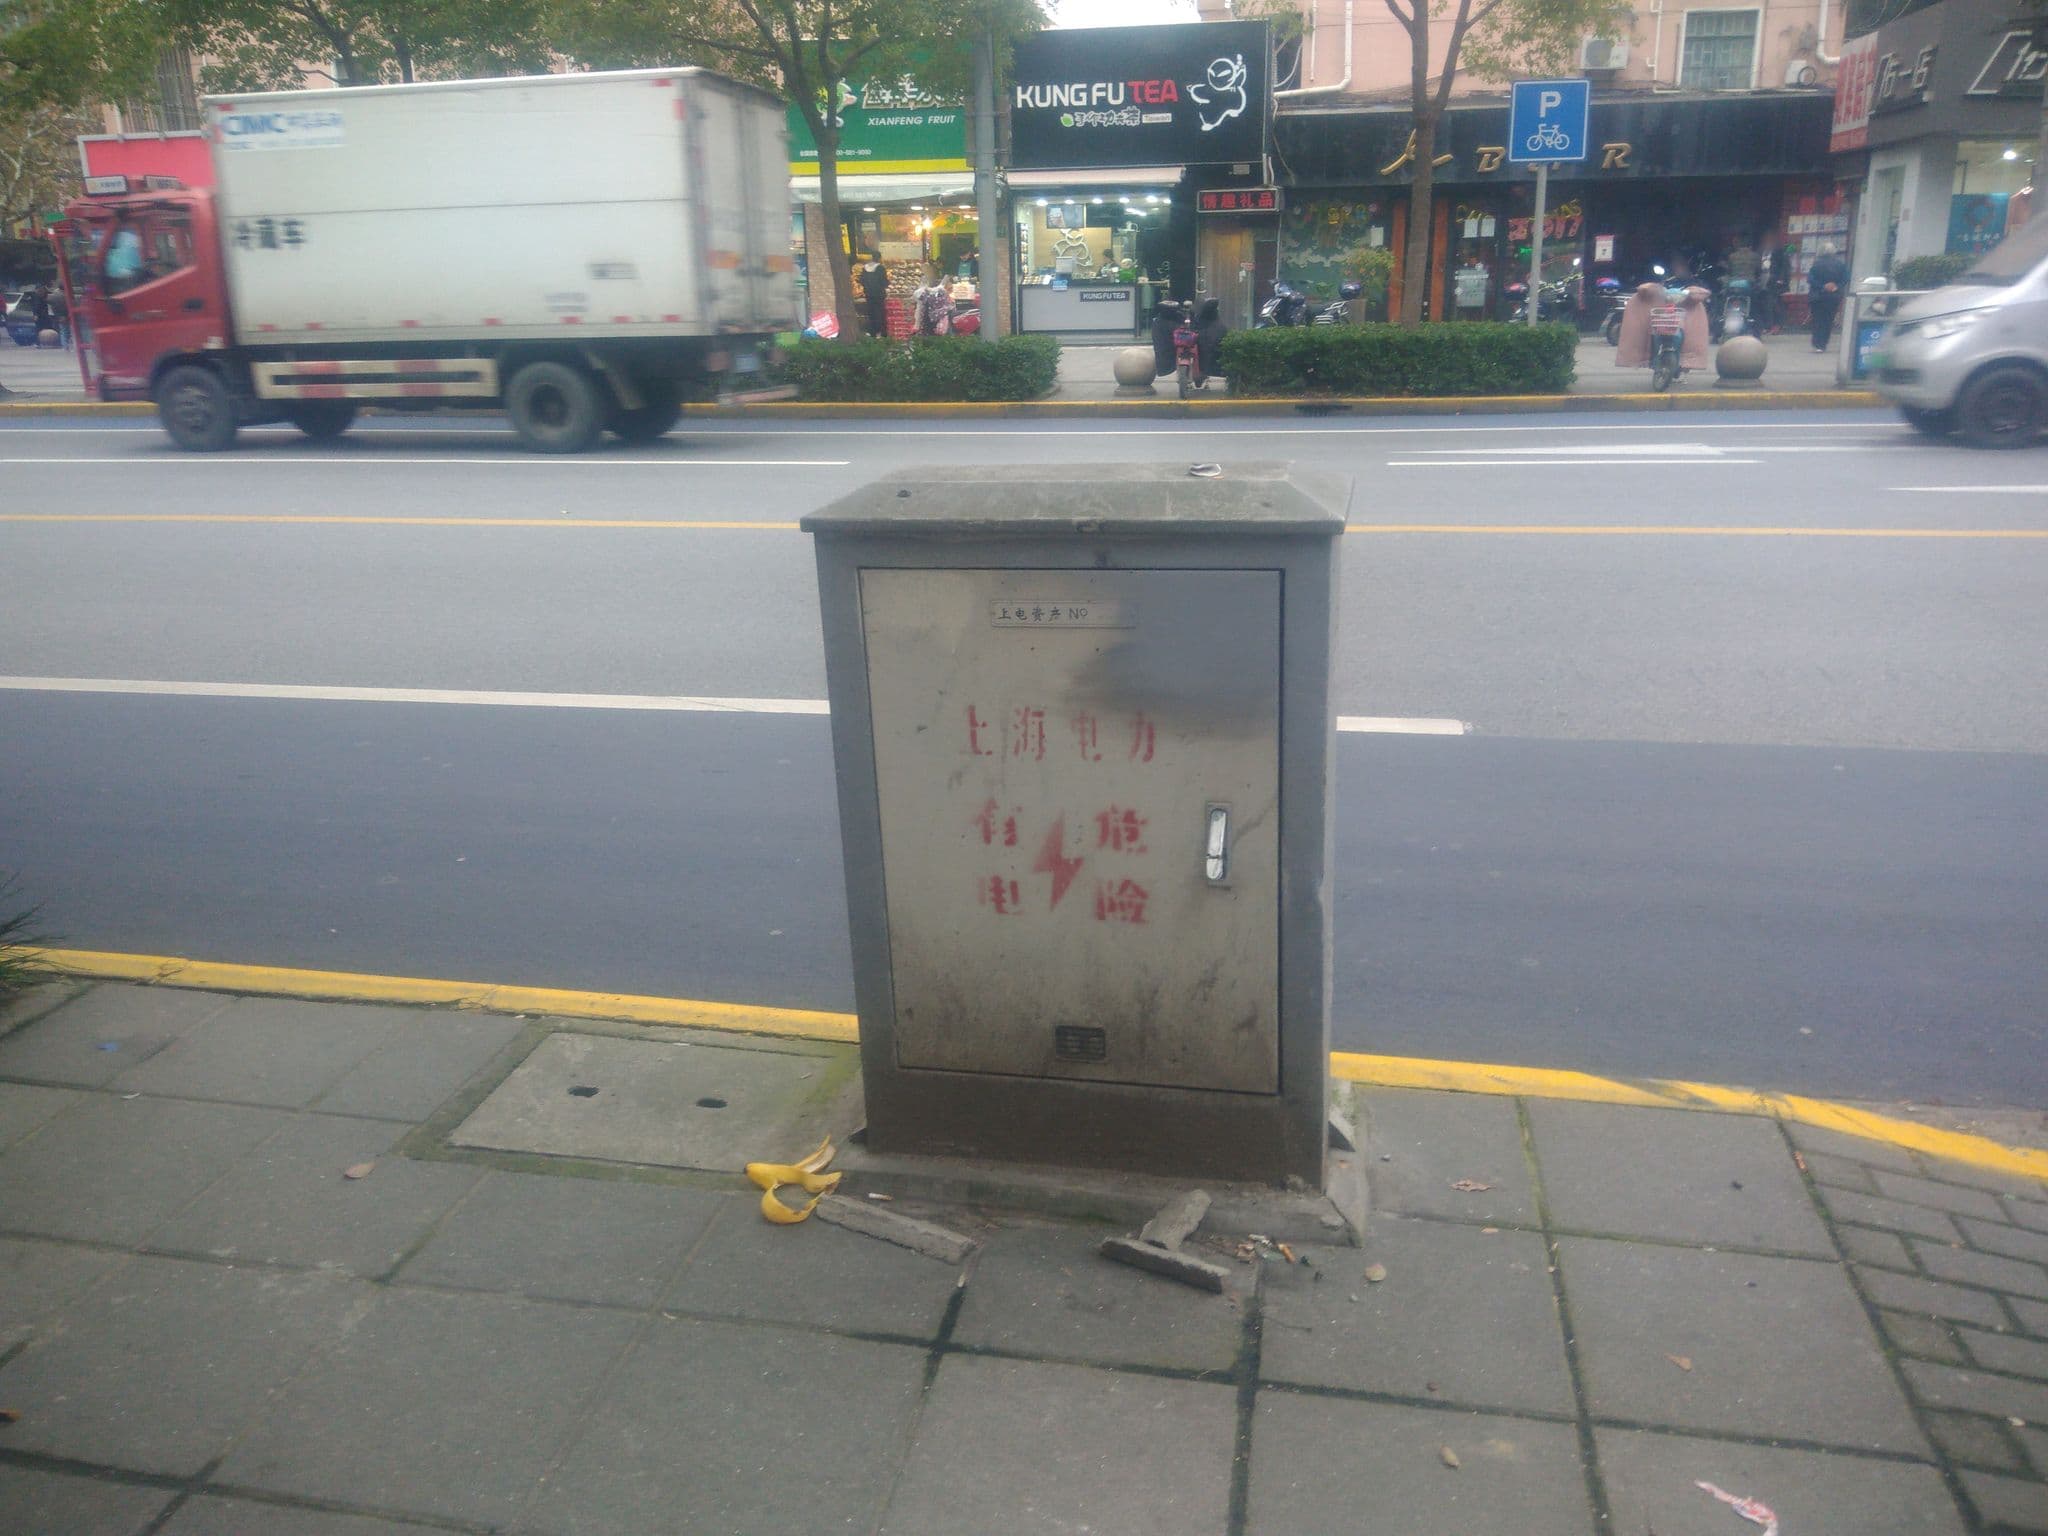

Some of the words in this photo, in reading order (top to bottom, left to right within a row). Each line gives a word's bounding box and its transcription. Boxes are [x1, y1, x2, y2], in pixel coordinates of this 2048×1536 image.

[1016, 83, 1087, 108] KUNG
[1092, 82, 1125, 105] FU
[1127, 79, 1179, 104] TEA
[1540, 91, 1562, 118] P
[867, 116, 923, 126] XIANFENG
[928, 115, 956, 124] FRUIT
[998, 606, 1061, 622] 上电资产
[967, 704, 1156, 763] 上海电力
